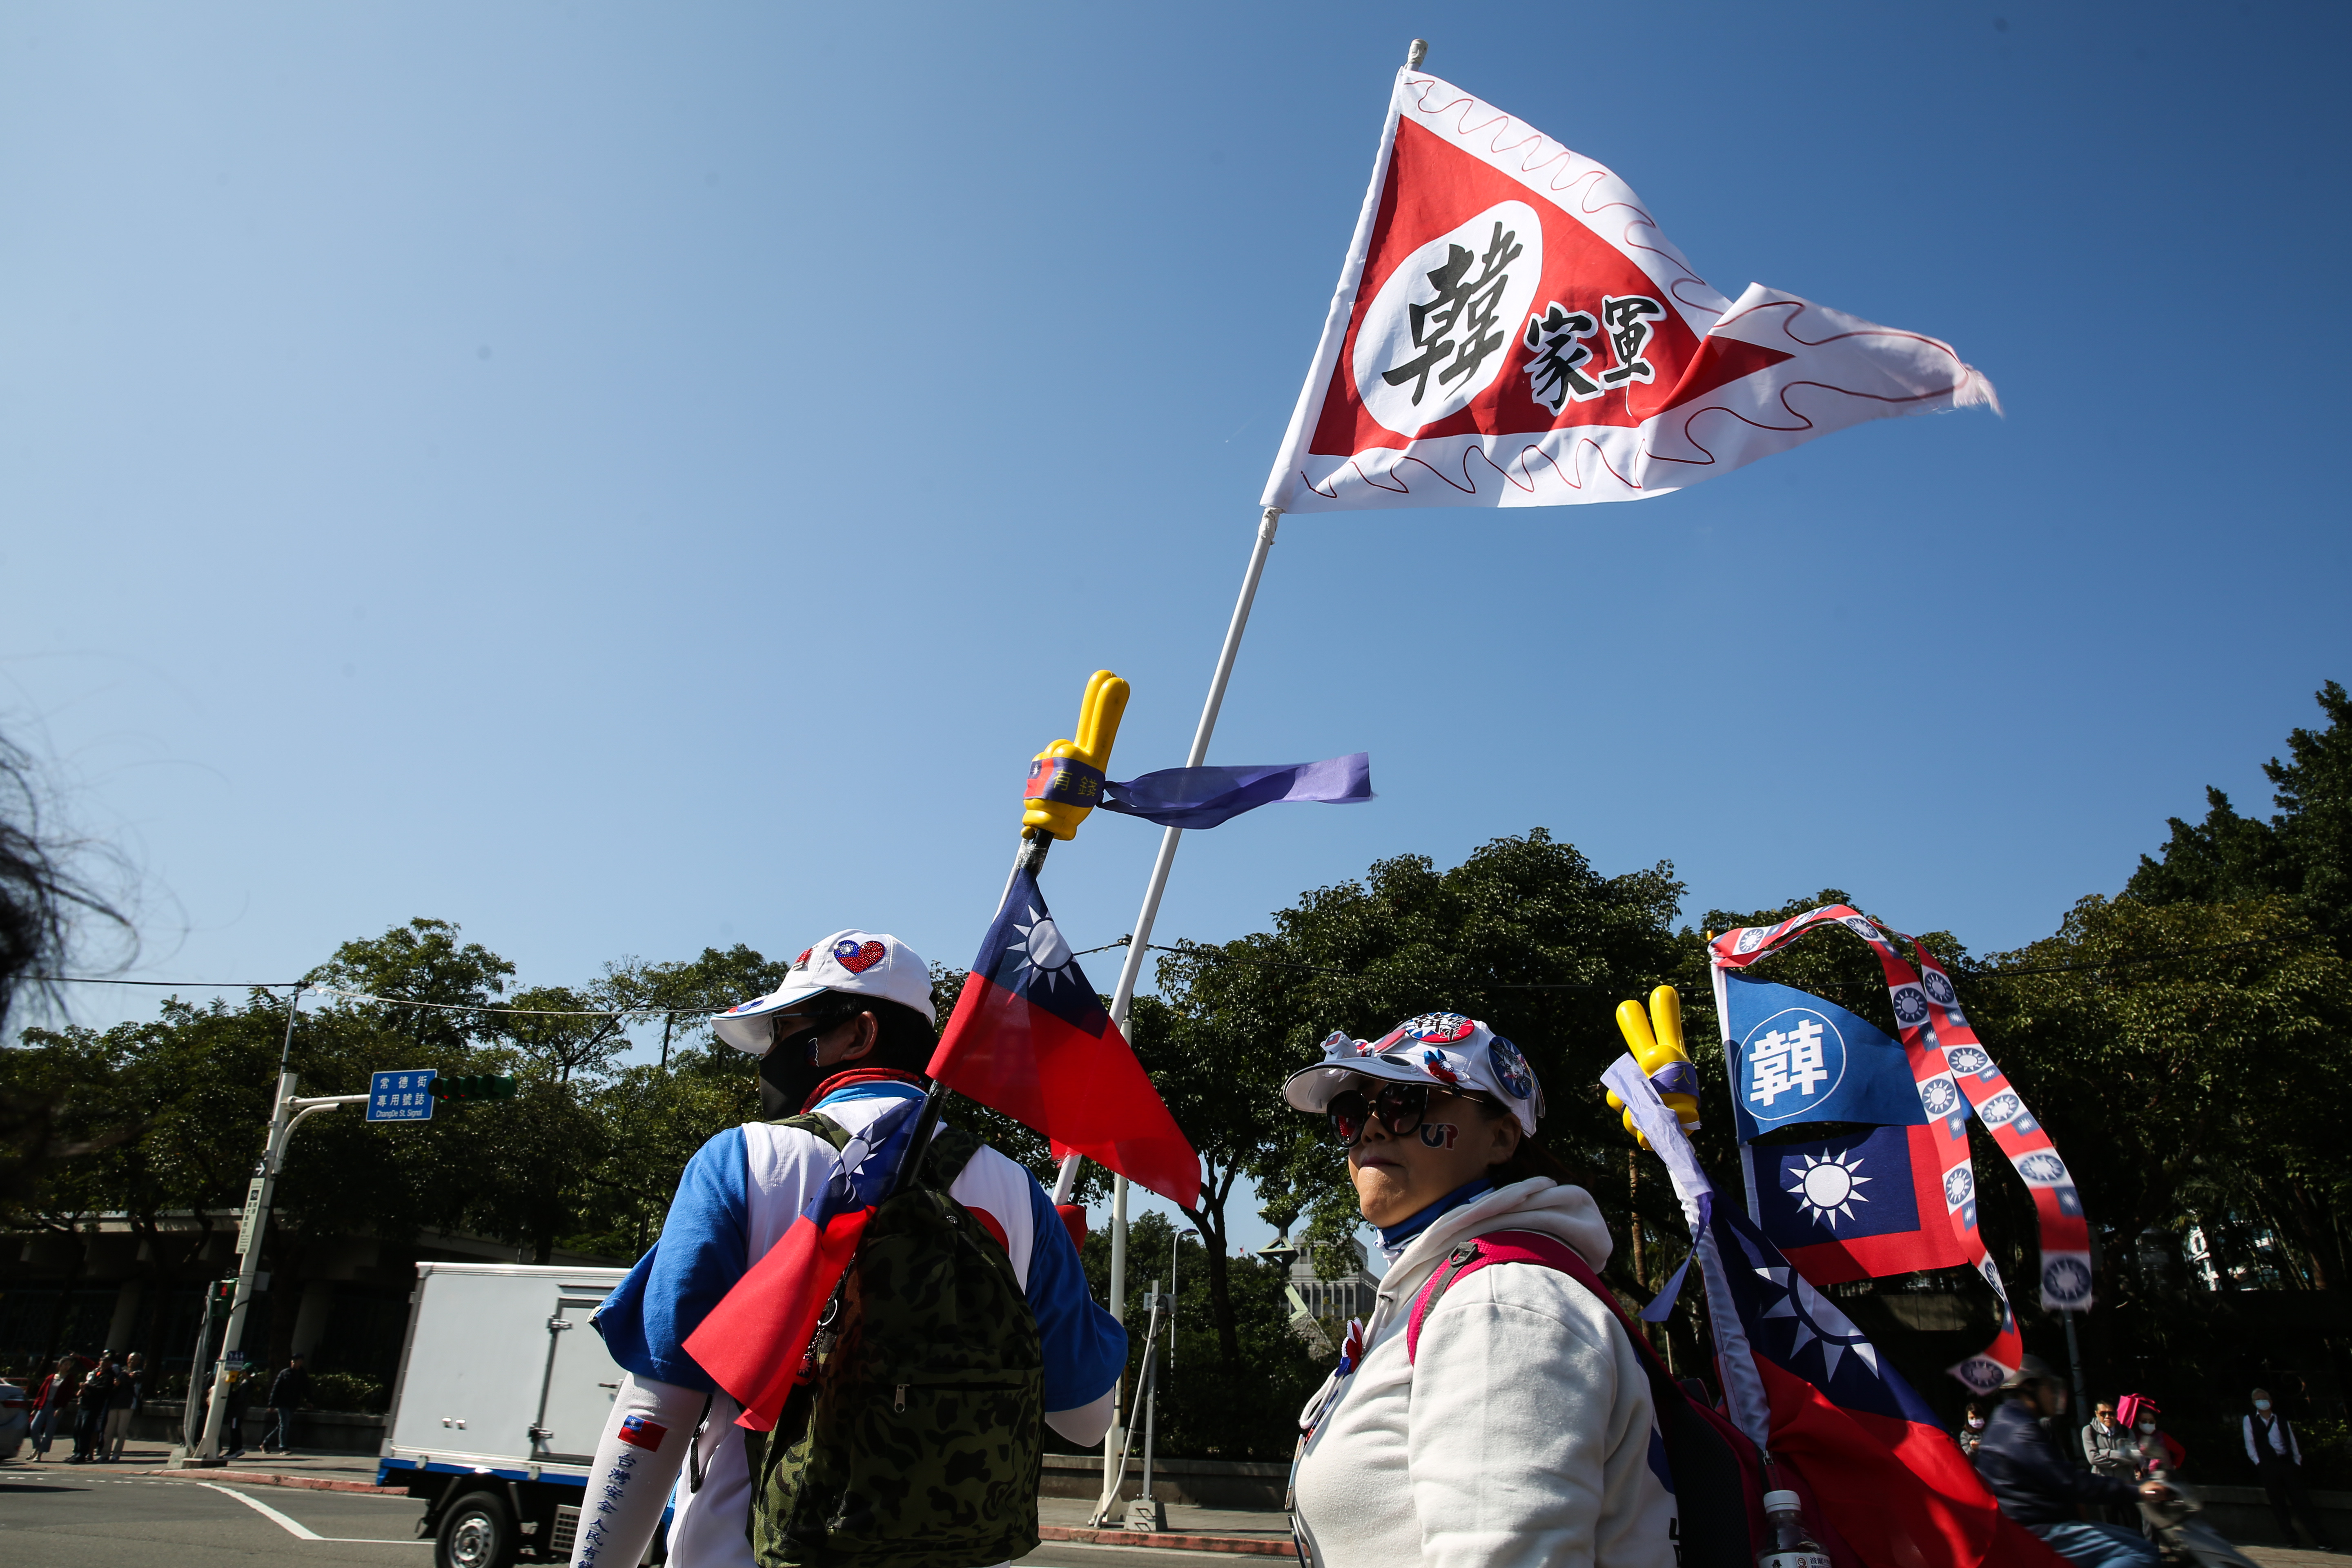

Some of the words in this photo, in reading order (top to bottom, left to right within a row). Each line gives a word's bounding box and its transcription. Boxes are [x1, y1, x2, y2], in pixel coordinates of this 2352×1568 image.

[1382, 221, 1523, 407] 韓
[1526, 297, 1661, 411] 家軍
[1053, 769, 1098, 797] 有錢
[380, 1076, 428, 1090] 常德街
[376, 1093, 425, 1107] 專用號誌
[376, 1109, 399, 1118] ChangDe
[407, 1109, 423, 1118] Signal
[1419, 1123, 1459, 1150] UP
[597, 1453, 637, 1514] 台灣安全
